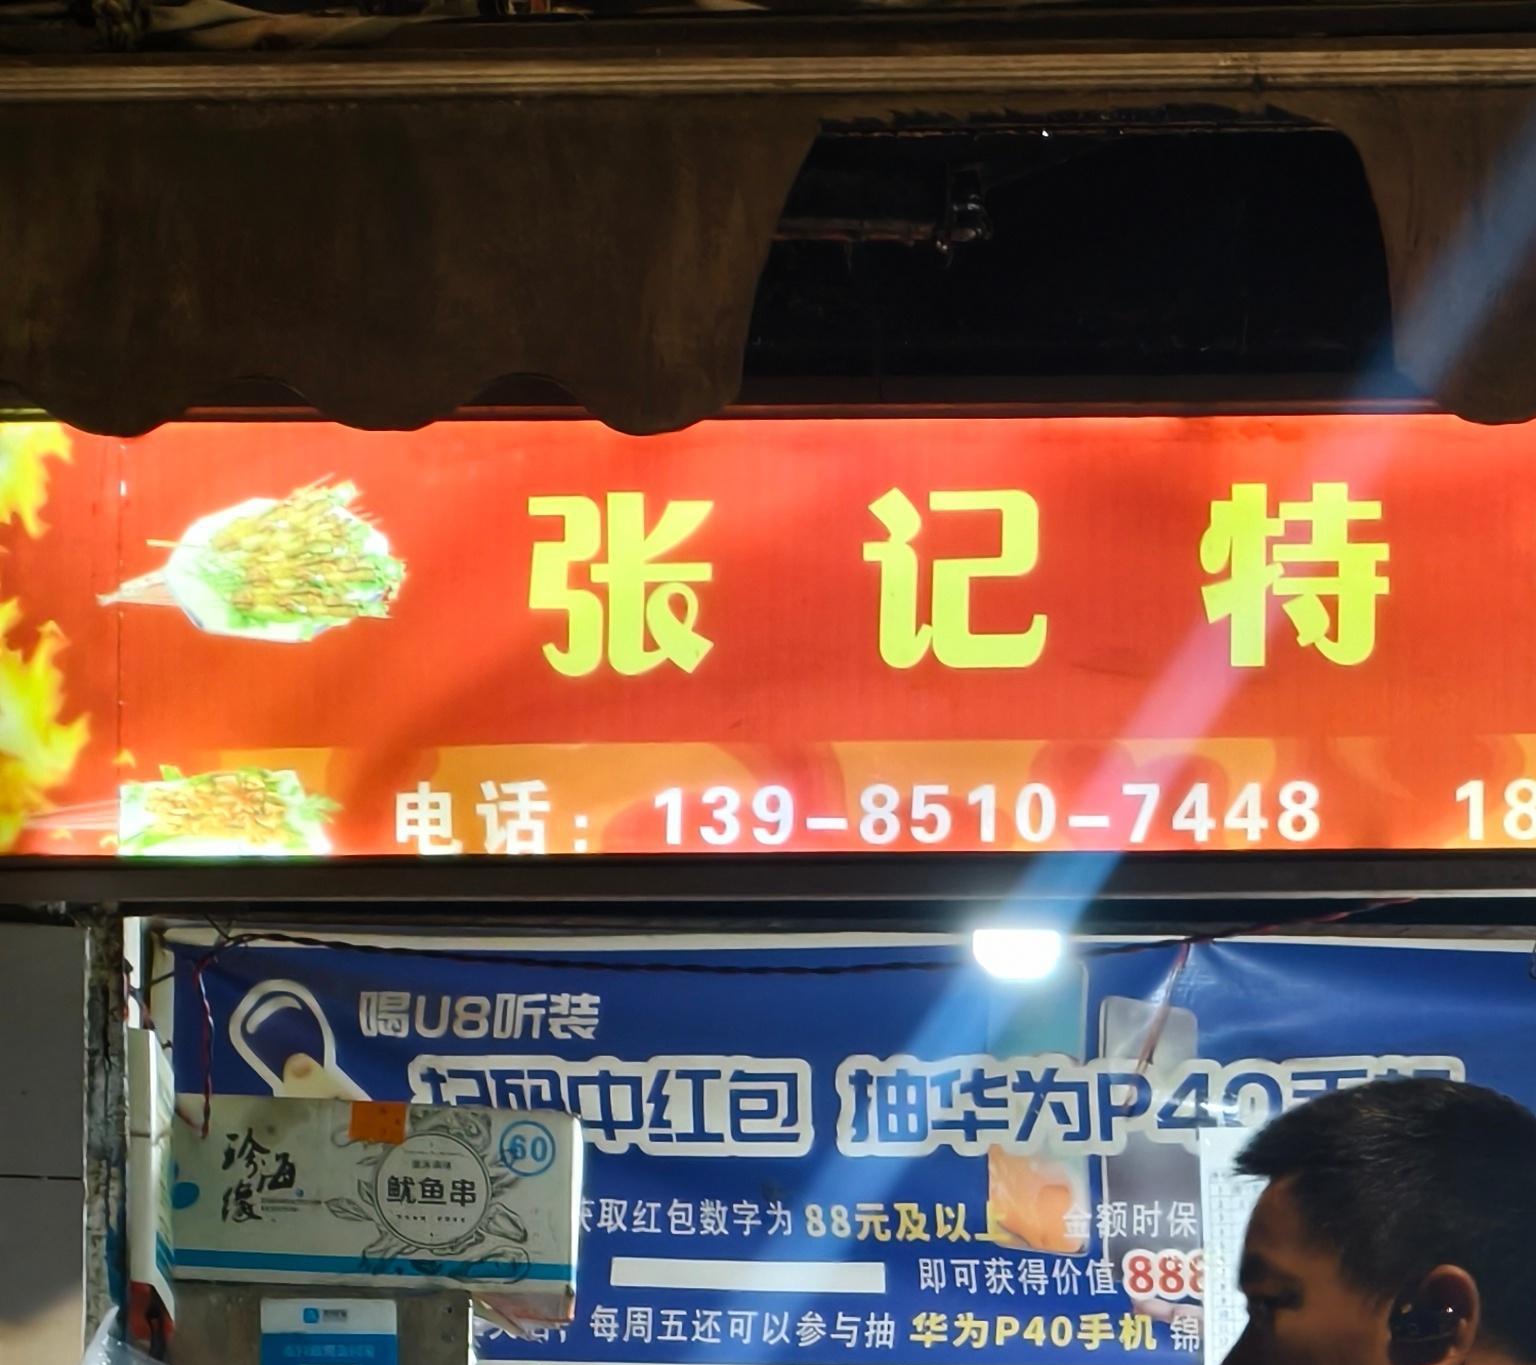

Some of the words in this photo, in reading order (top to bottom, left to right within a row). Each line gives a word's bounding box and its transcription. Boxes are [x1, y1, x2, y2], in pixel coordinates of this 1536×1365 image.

[653, 781, 1322, 848] 139-8510-7448
[359, 990, 600, 1040] 喝U8听装
[848, 1066, 1451, 1143] 抽华为P40
[510, 1133, 544, 1163] 60
[387, 1175, 477, 1208] 鱿鱼串
[1063, 1200, 1199, 1239] 金额时保
[918, 1257, 1118, 1296] 即可获得价值
[590, 1304, 896, 1349] 每周五还可以参与抽
[909, 1311, 1157, 1351] 华为P40手机
